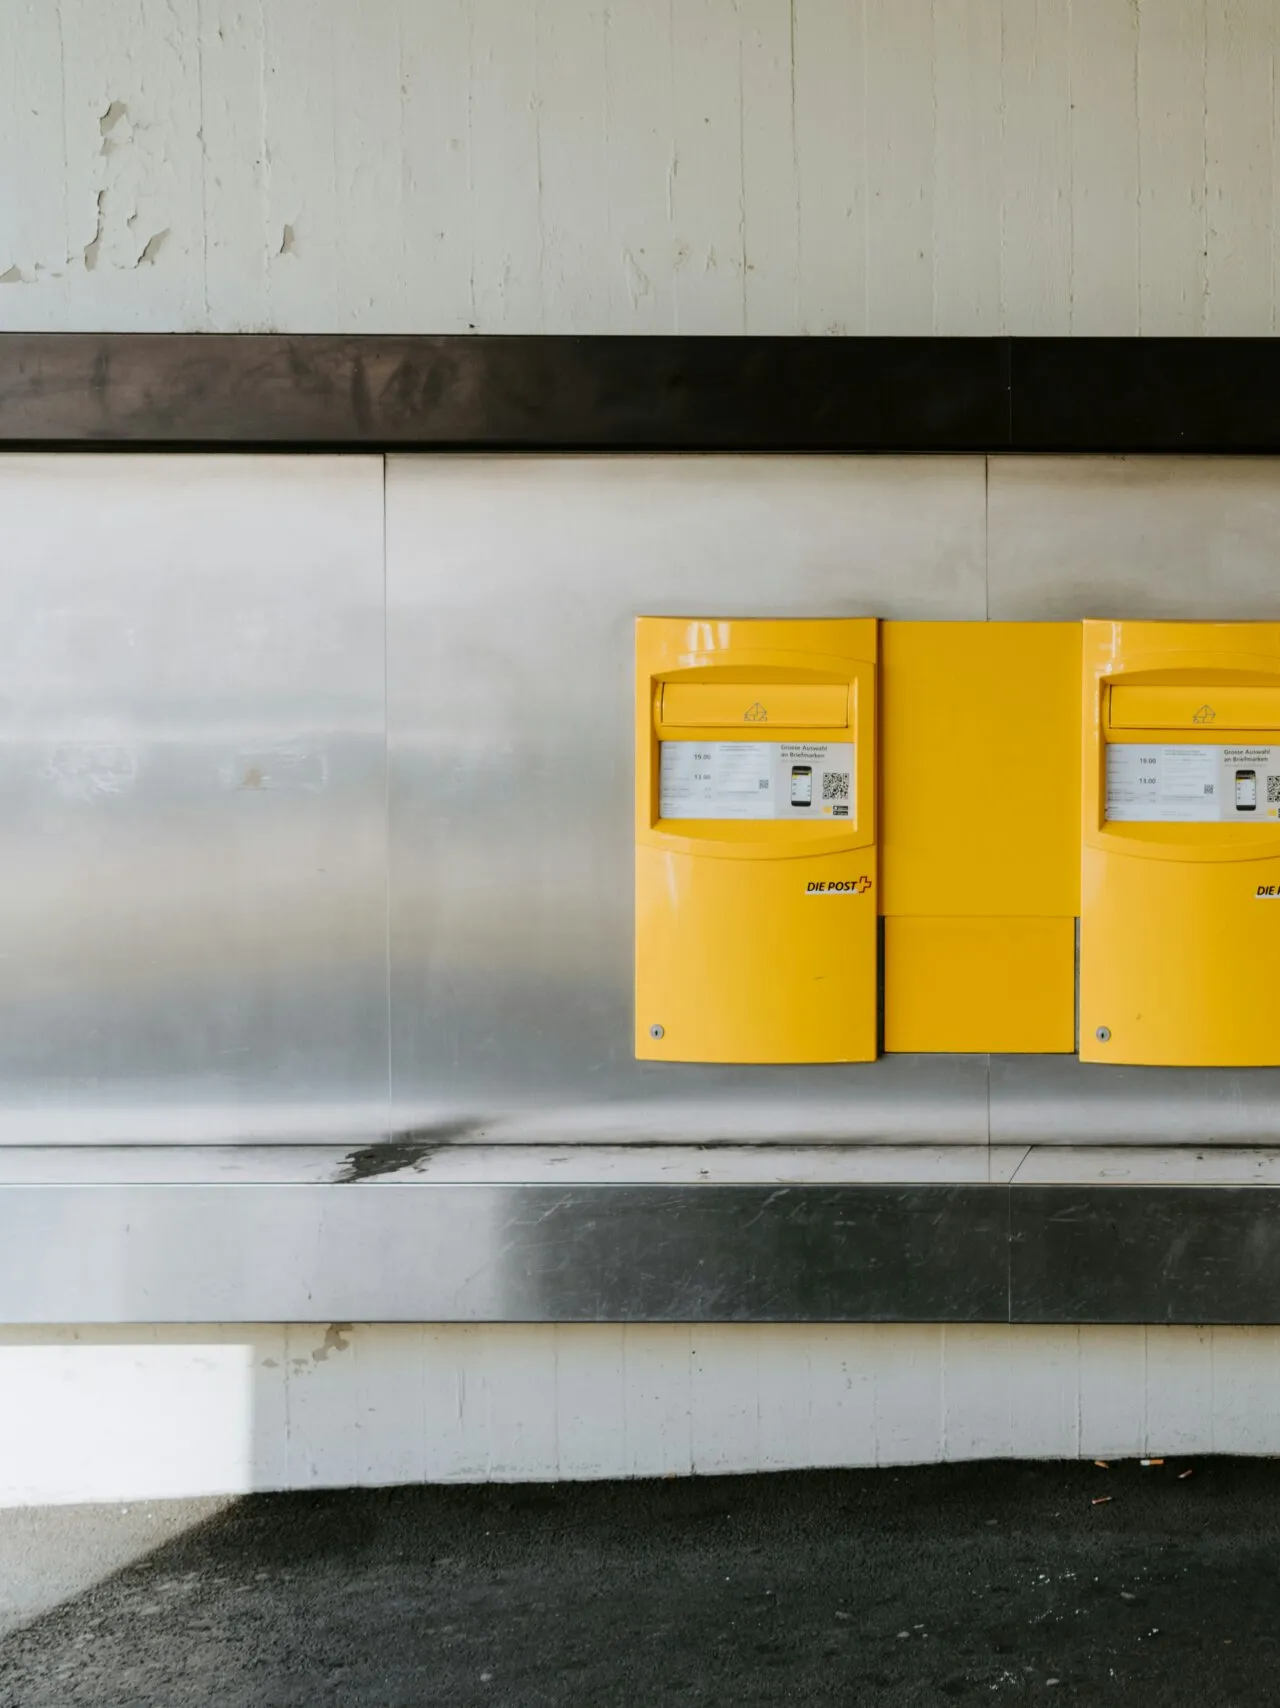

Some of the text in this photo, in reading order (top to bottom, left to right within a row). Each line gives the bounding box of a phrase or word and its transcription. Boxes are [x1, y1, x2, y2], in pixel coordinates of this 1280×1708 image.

[807, 881, 857, 891] DIE POST
[1257, 885, 1275, 895] DIE
